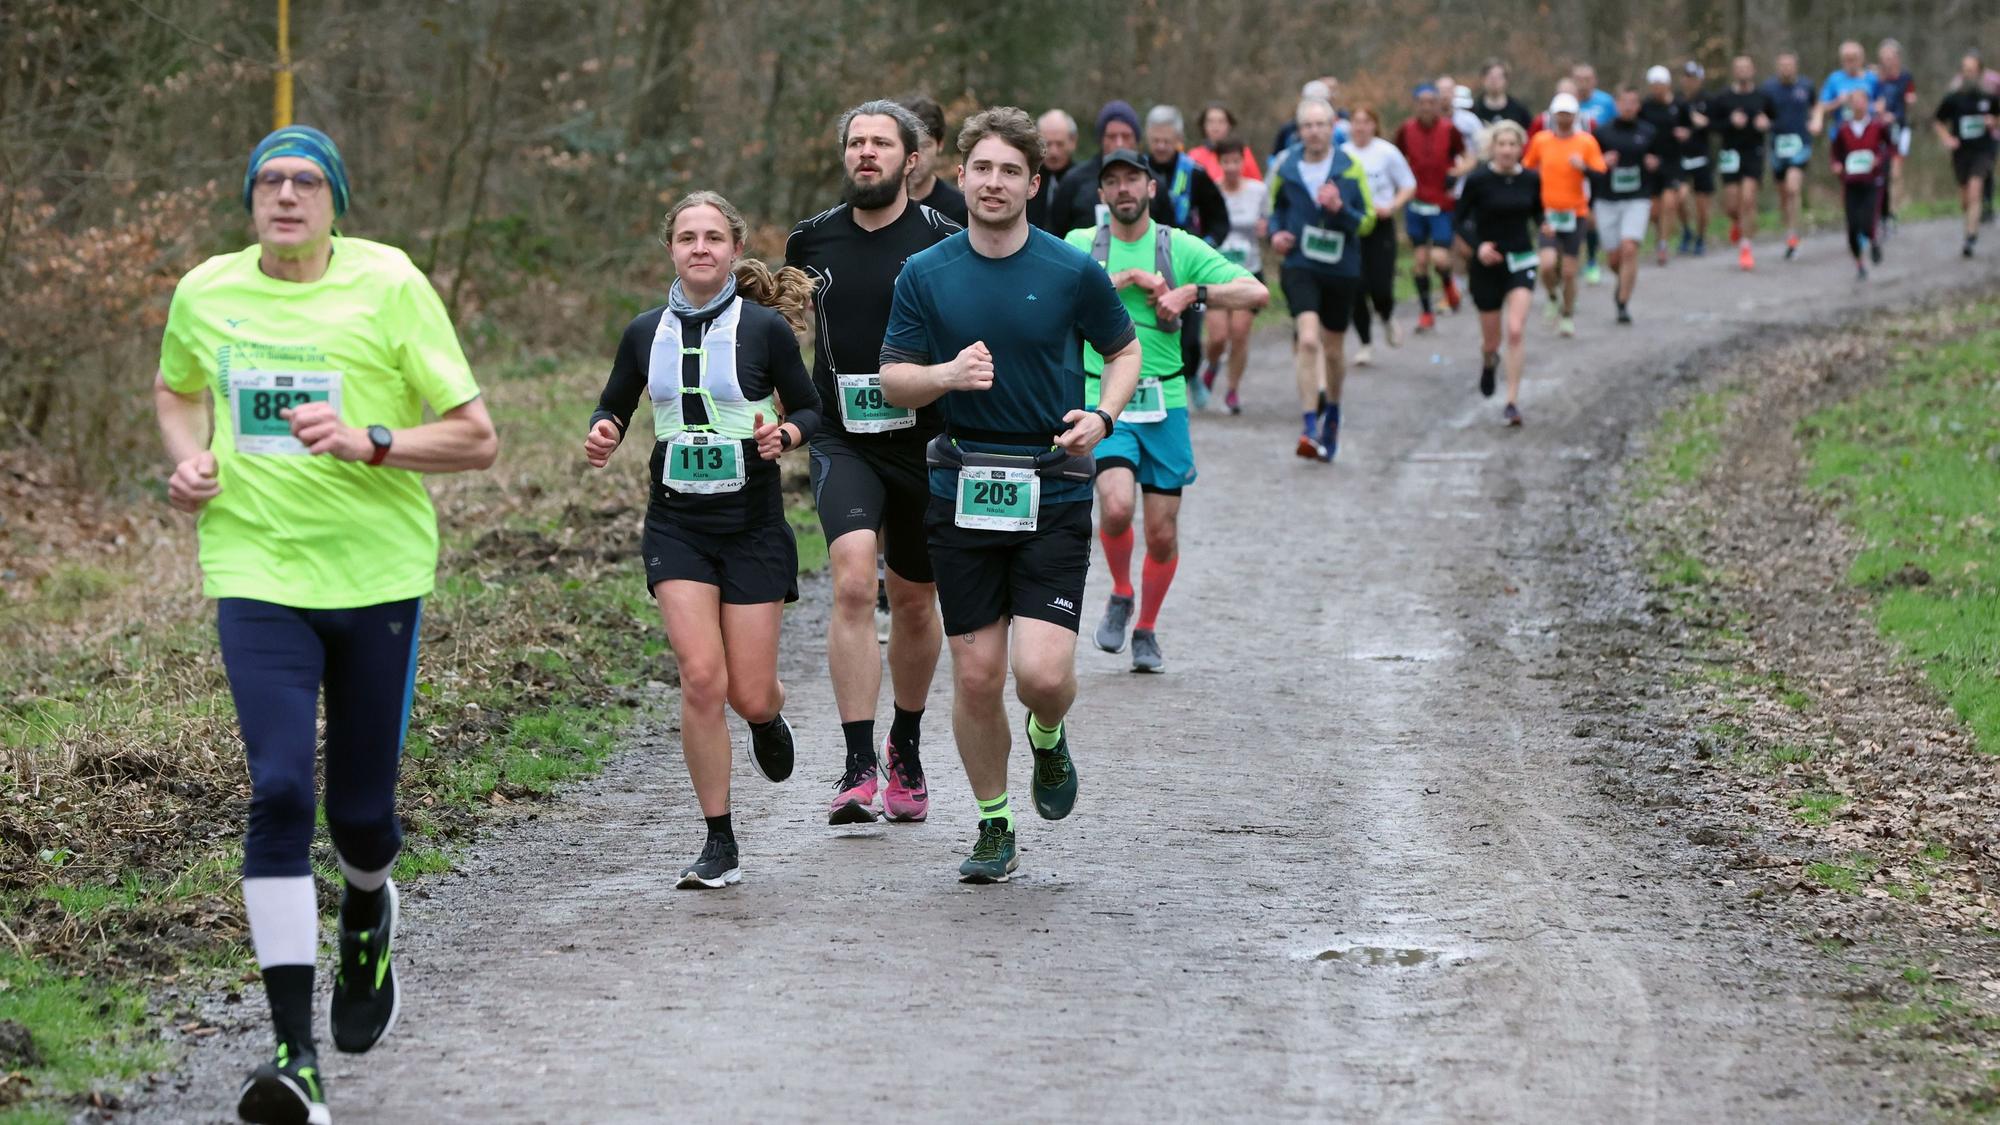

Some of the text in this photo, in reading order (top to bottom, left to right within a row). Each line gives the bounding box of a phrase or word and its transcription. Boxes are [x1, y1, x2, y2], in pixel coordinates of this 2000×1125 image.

[680, 447, 723, 470] 113
[973, 482, 1018, 506] 203
[1053, 596, 1074, 610] JAKO
